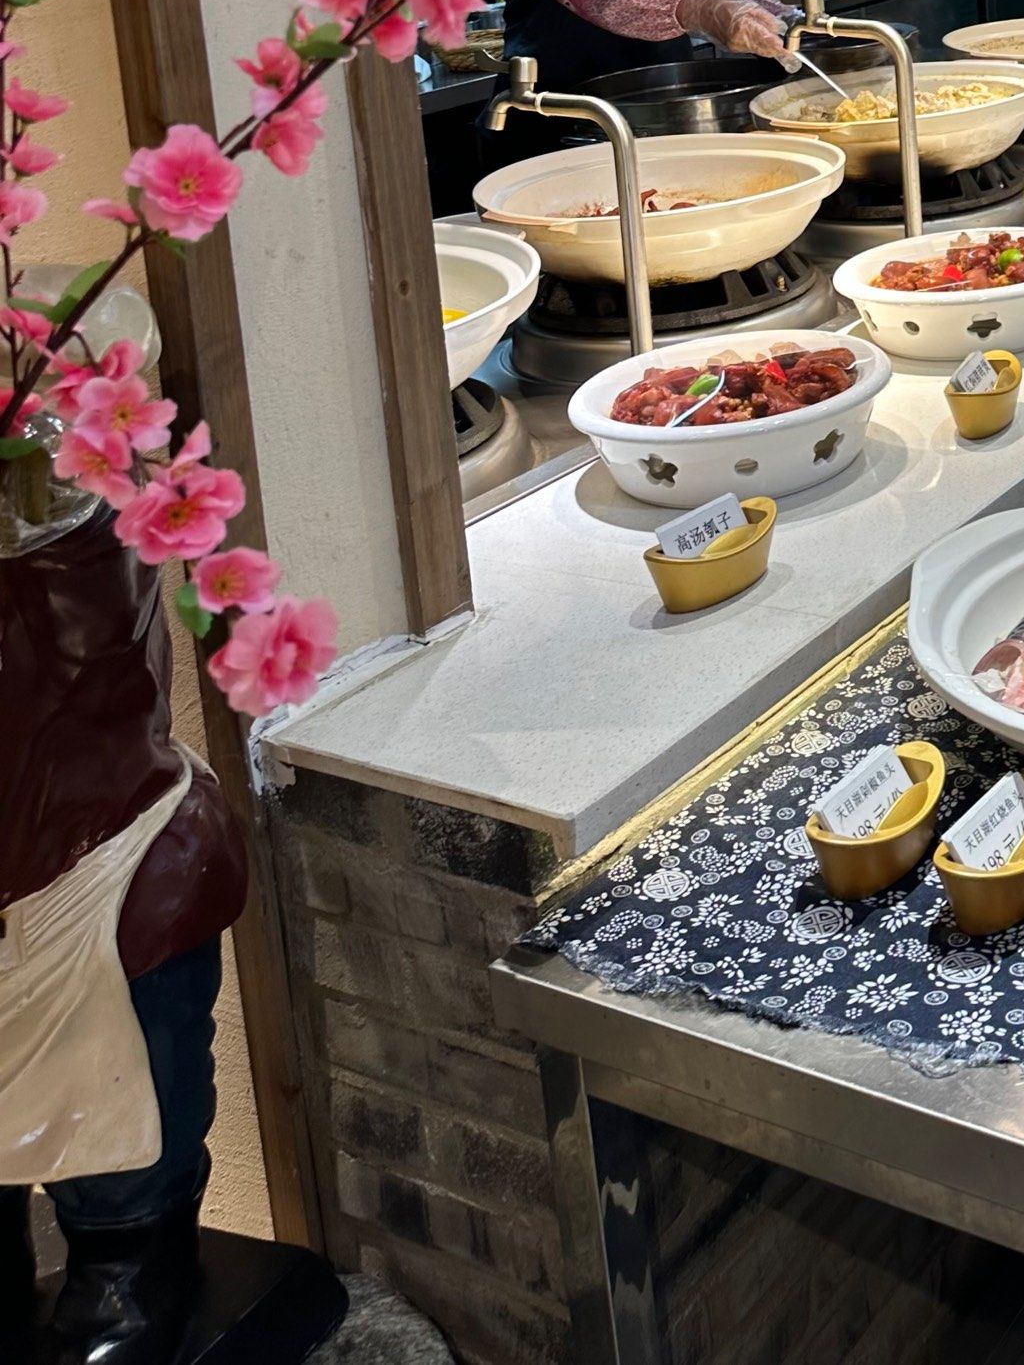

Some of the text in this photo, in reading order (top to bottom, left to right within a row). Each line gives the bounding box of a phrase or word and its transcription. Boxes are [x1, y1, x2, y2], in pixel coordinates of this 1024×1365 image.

[674, 511, 731, 554] 高汤瓠子
[835, 763, 896, 821] 天目湖剁椒鱼头
[964, 789, 1024, 854] 天目湖红烧鱼头
